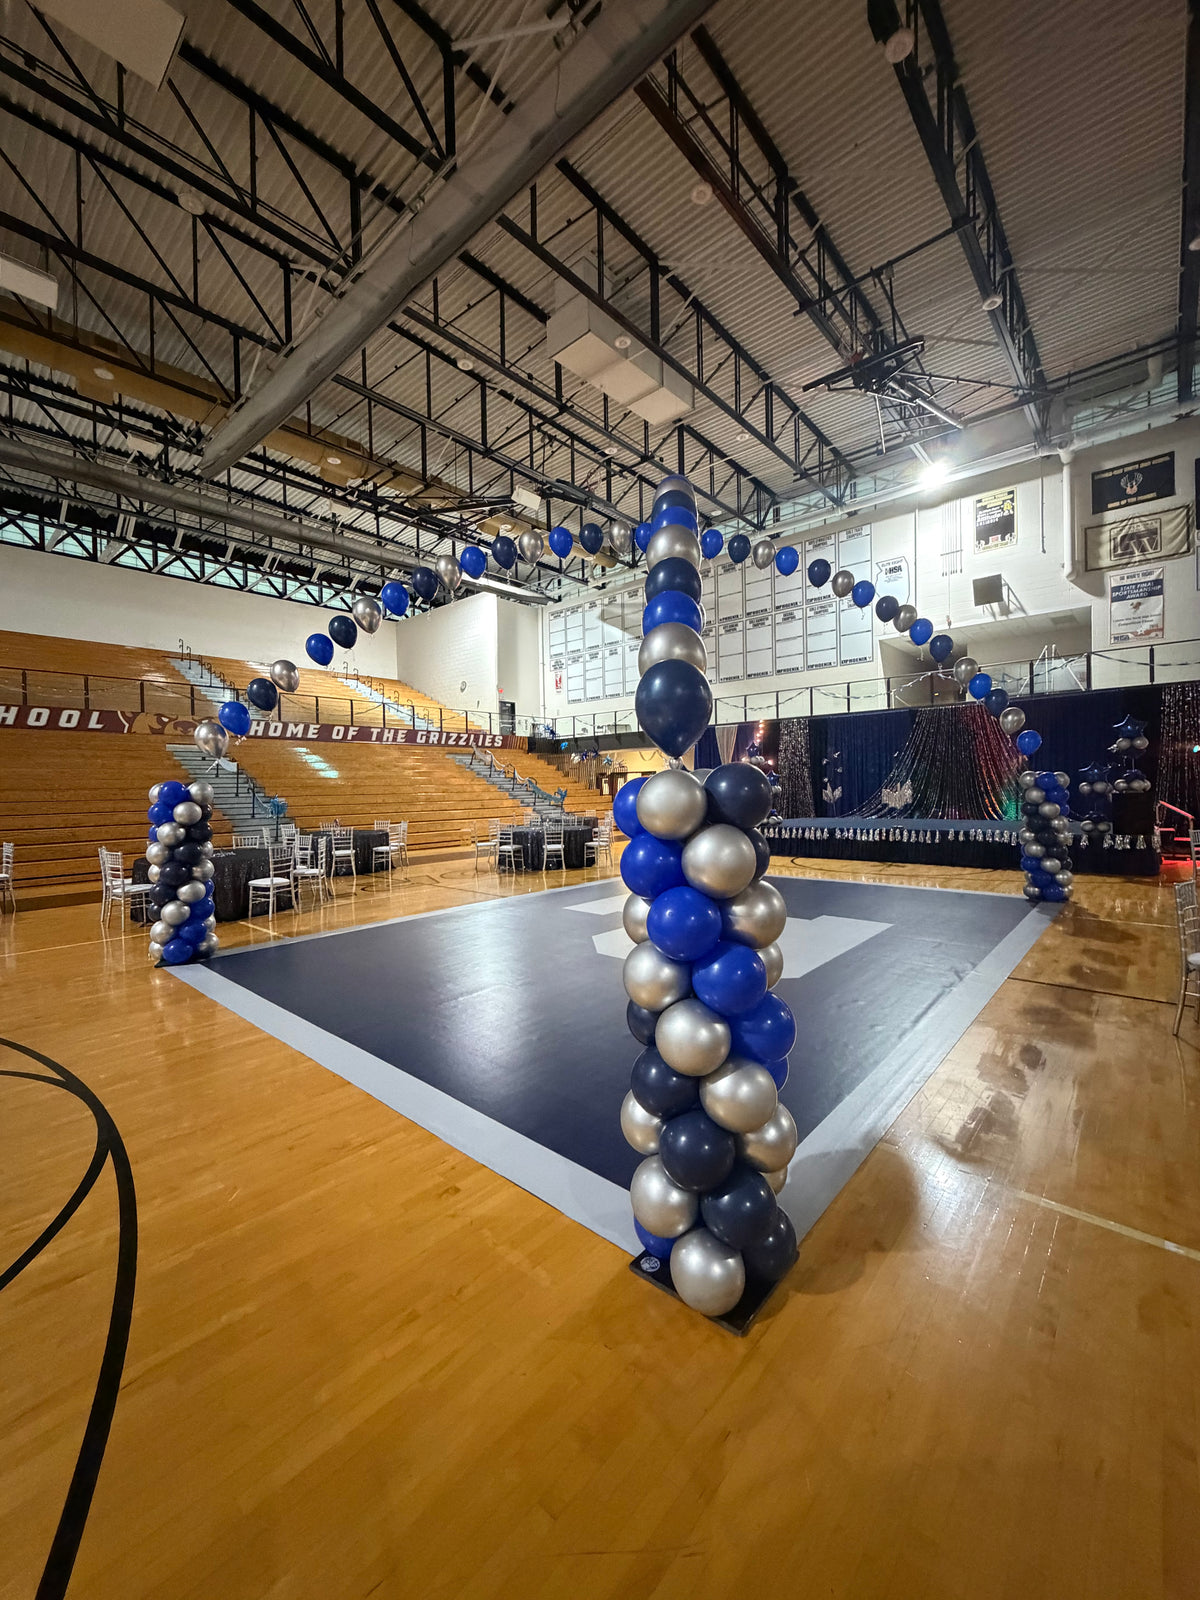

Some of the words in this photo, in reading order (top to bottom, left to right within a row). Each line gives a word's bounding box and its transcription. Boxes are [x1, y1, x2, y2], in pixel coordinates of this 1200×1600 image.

[1112, 585, 1161, 597] SPORTSMANSHIP
[0, 705, 104, 729] HOOL
[250, 720, 321, 739] HOME
[332, 726, 359, 742] OF
[370, 727, 407, 743] THE
[416, 731, 503, 747] GRIZZLIES
